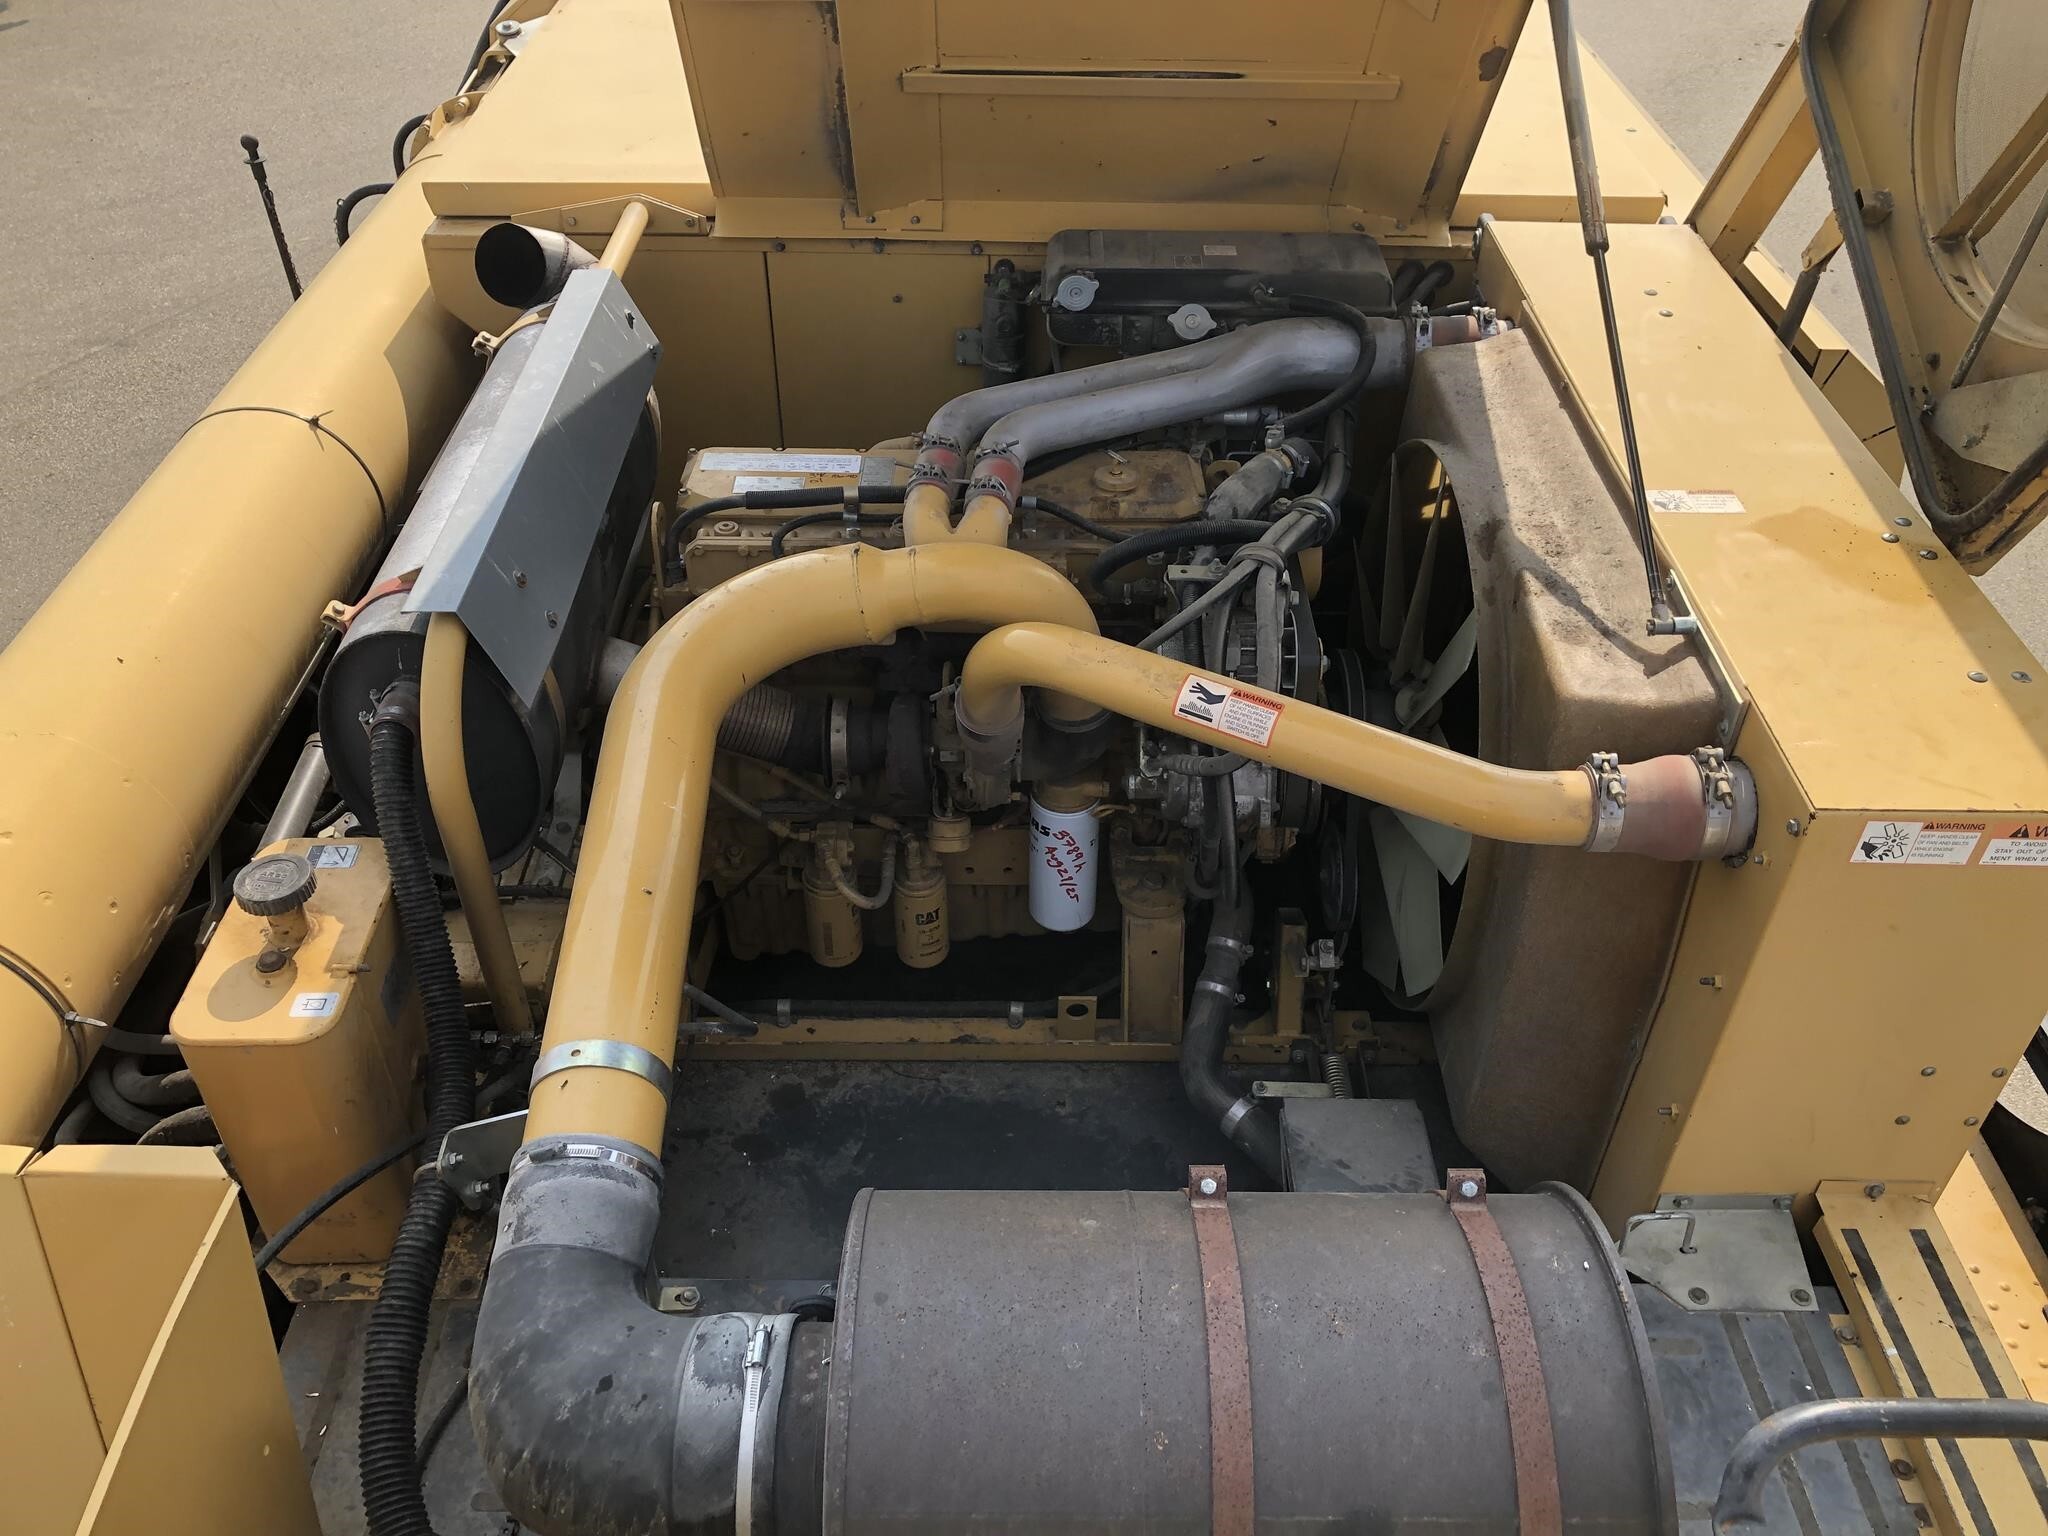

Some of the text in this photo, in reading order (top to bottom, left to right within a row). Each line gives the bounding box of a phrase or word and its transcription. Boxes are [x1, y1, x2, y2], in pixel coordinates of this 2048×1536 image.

[1242, 702, 1259, 711] HANDS
[1243, 692, 1283, 710] WARNING
[1247, 721, 1269, 731] RUNNING
[915, 907, 940, 925] CAT
